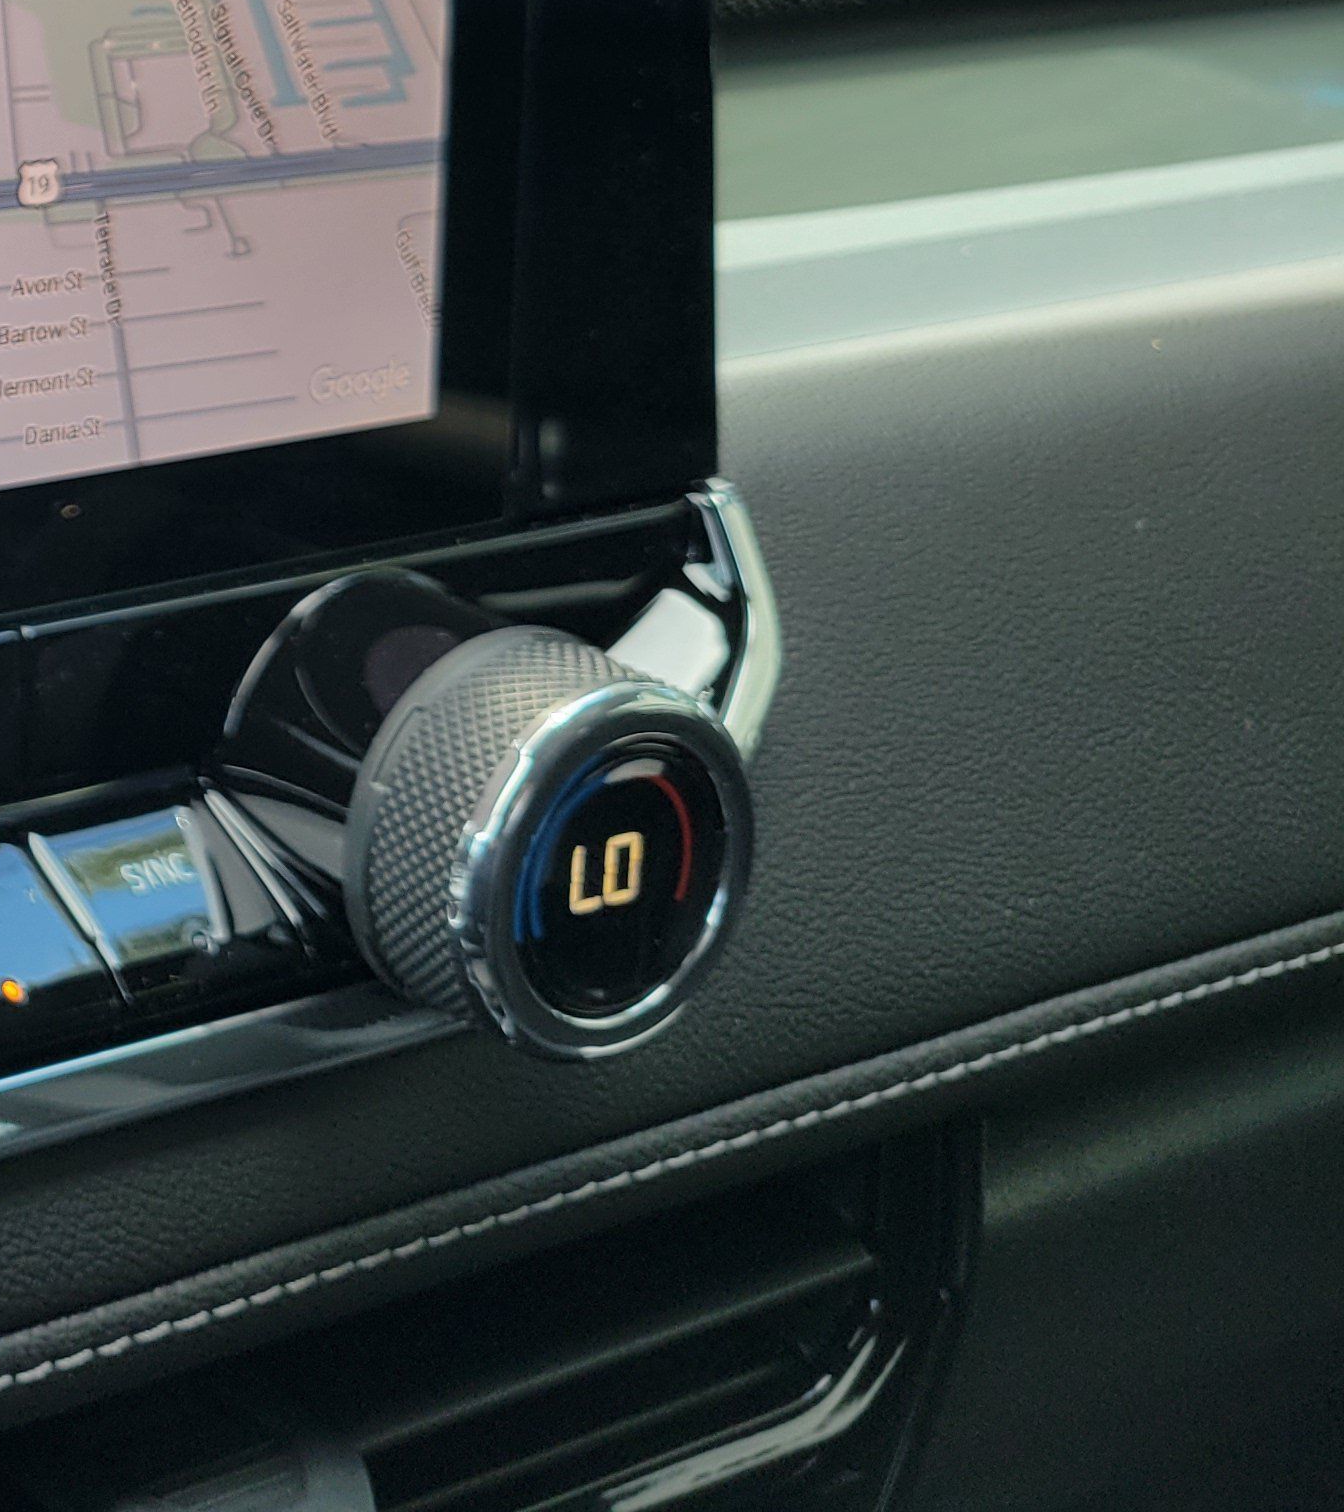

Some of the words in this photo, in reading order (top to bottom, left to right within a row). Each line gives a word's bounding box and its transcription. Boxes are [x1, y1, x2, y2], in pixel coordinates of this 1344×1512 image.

[29, 175, 49, 195] 19
[12, 275, 57, 295] Avon
[309, 360, 412, 404] Google
[120, 849, 193, 893] SYNC
